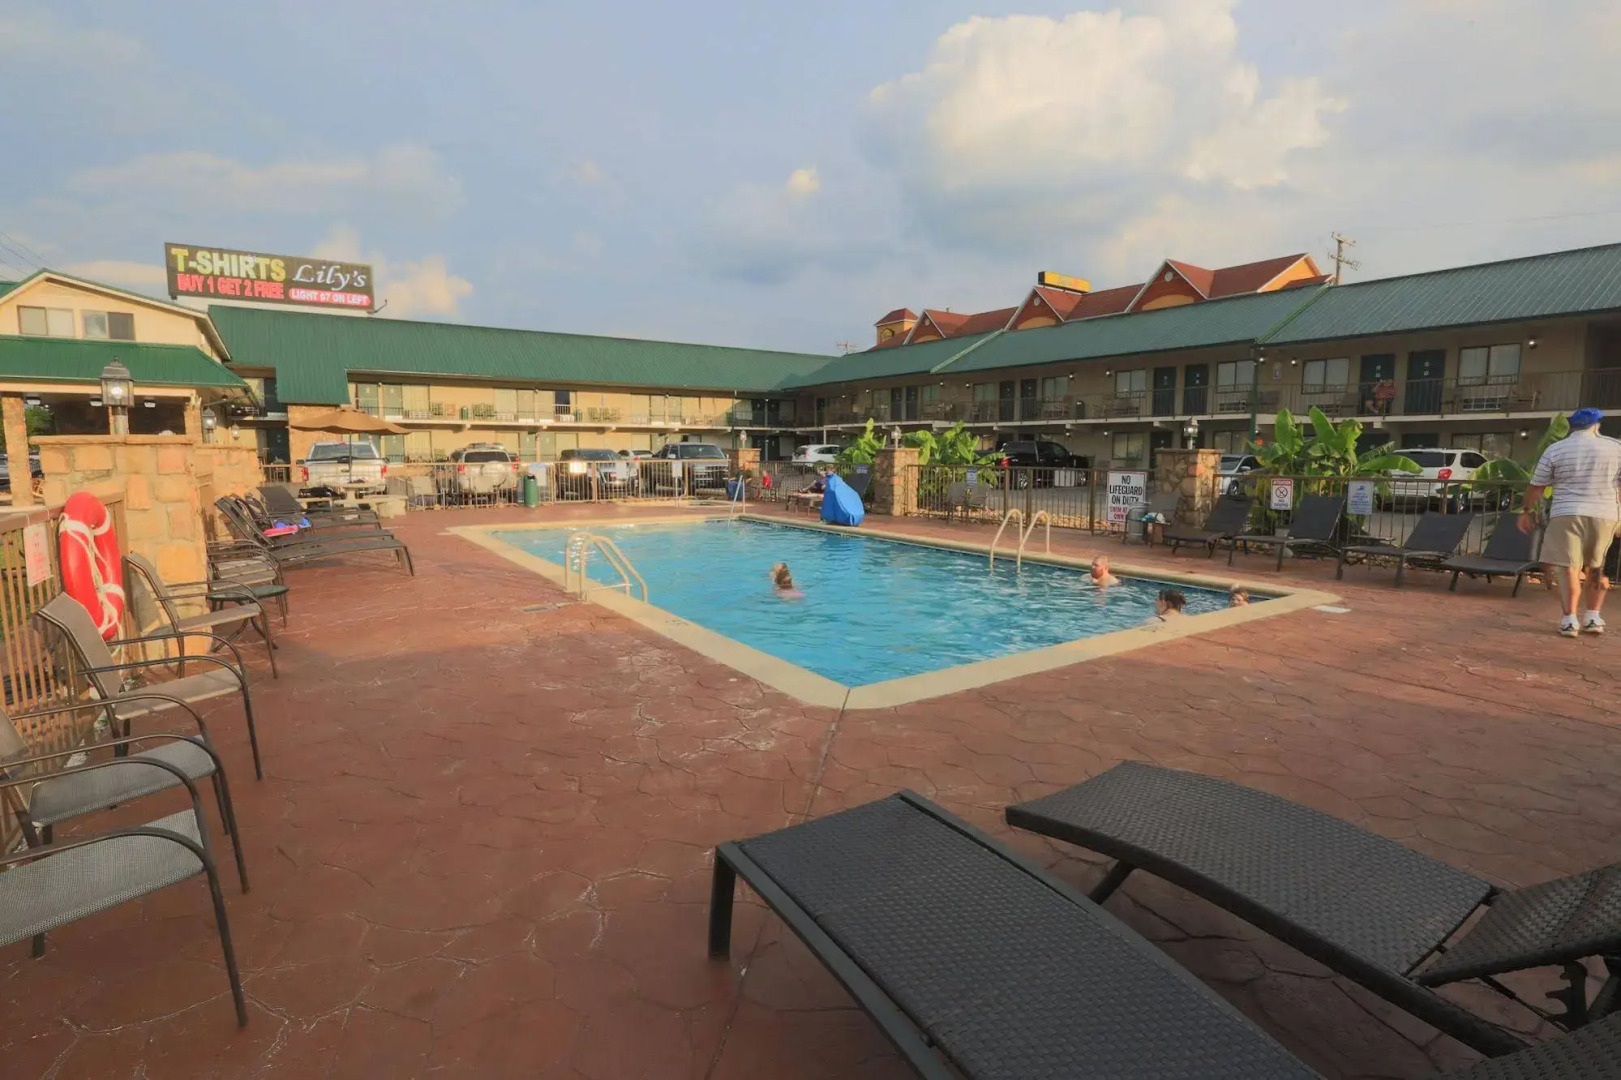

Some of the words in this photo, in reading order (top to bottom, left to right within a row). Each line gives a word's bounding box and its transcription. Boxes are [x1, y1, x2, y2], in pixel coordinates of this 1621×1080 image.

[171, 248, 286, 281] T-SHIRTS
[292, 264, 367, 291] Lily's
[177, 273, 204, 293] BUY
[207, 276, 214, 293] 1
[217, 277, 242, 296] GET
[244, 279, 252, 297] 2
[254, 280, 284, 299] FREE
[291, 288, 319, 301] LIGHT
[1121, 475, 1131, 485] NO
[1109, 485, 1143, 496] LIFEGUARD
[1111, 495, 1121, 505] ON
[1122, 496, 1139, 506] DUTY
